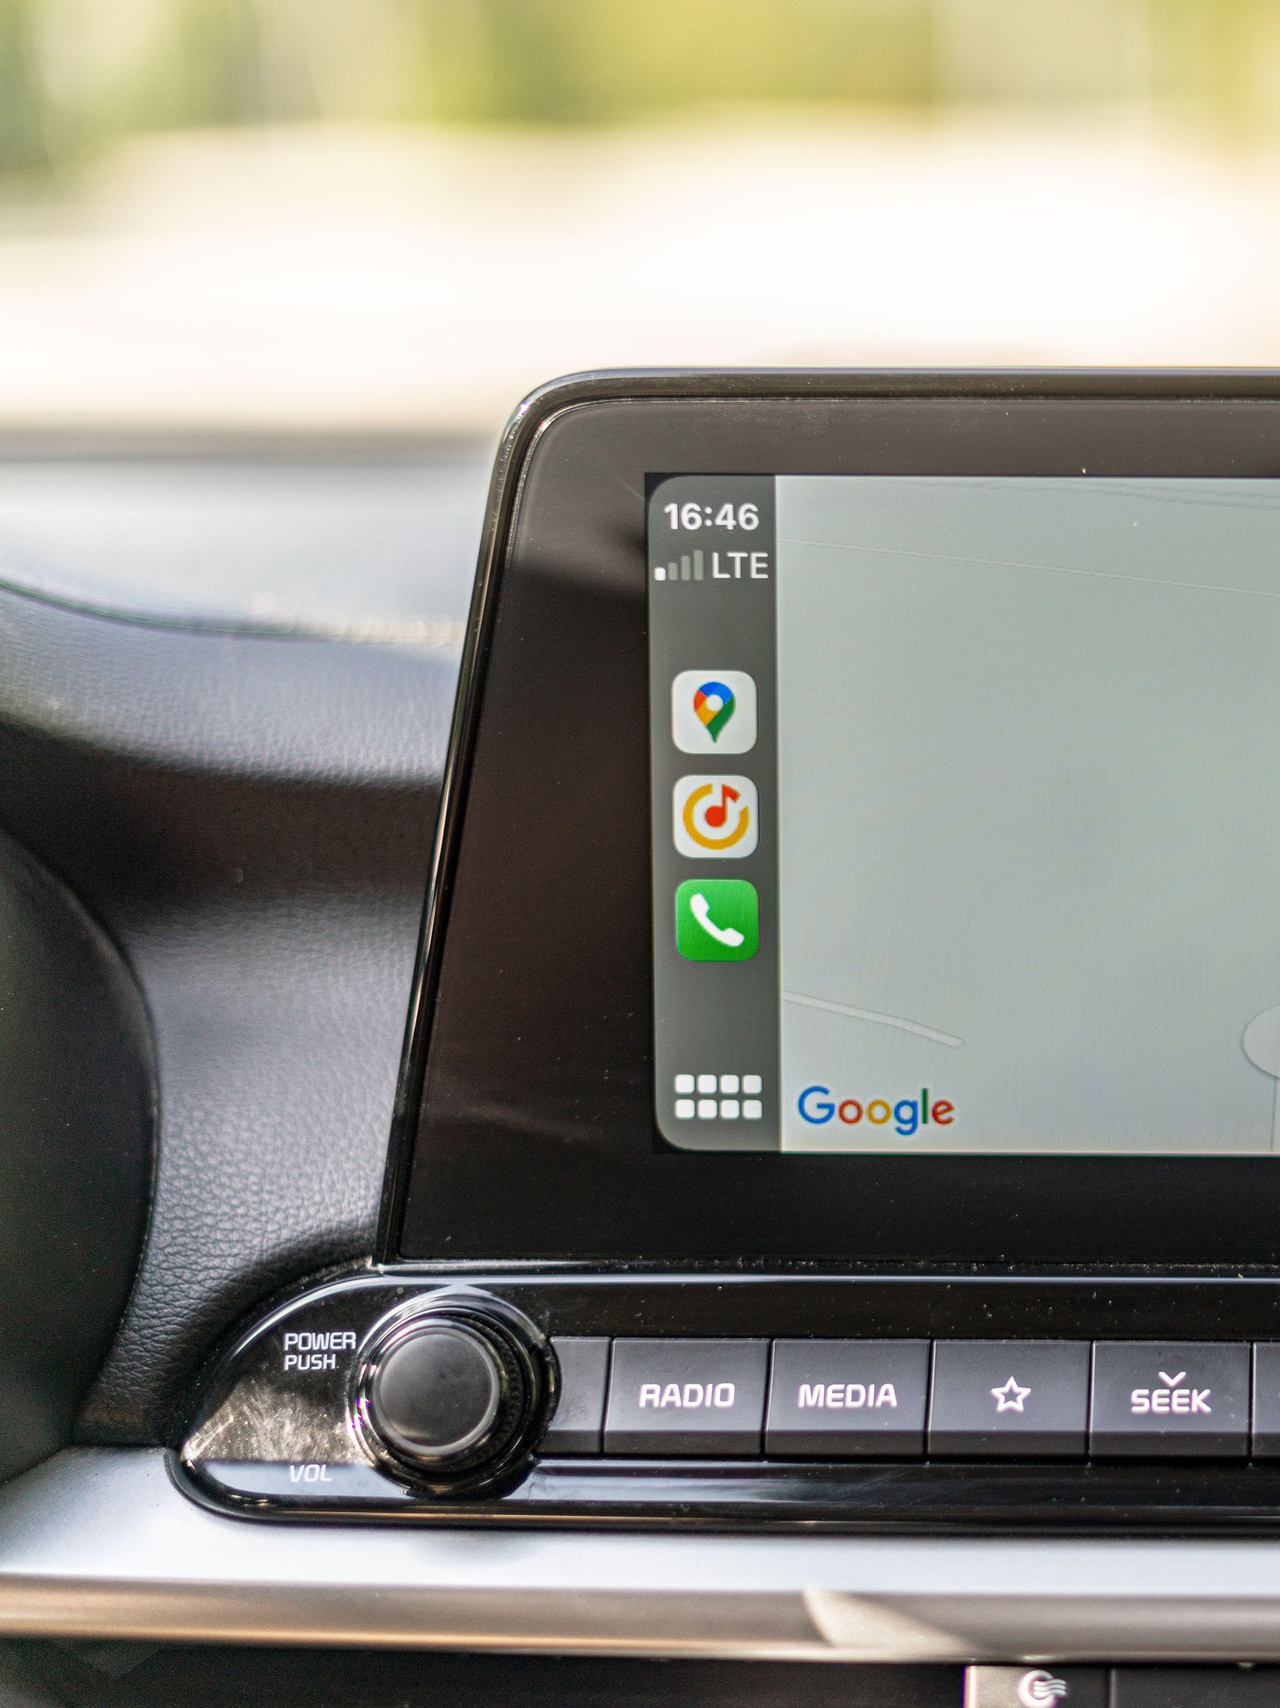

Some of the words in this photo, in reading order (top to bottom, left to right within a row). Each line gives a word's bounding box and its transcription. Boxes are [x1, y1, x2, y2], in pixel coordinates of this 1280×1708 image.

[664, 503, 760, 530] 16:46
[712, 552, 769, 579] LTE
[798, 1086, 955, 1135] Google
[284, 1332, 357, 1350] POWER
[284, 1354, 336, 1370] PUSH
[639, 1383, 736, 1409] RADIO
[798, 1383, 898, 1409] MEDIA
[1131, 1389, 1213, 1415] SEEK
[288, 1464, 333, 1483] VOL
